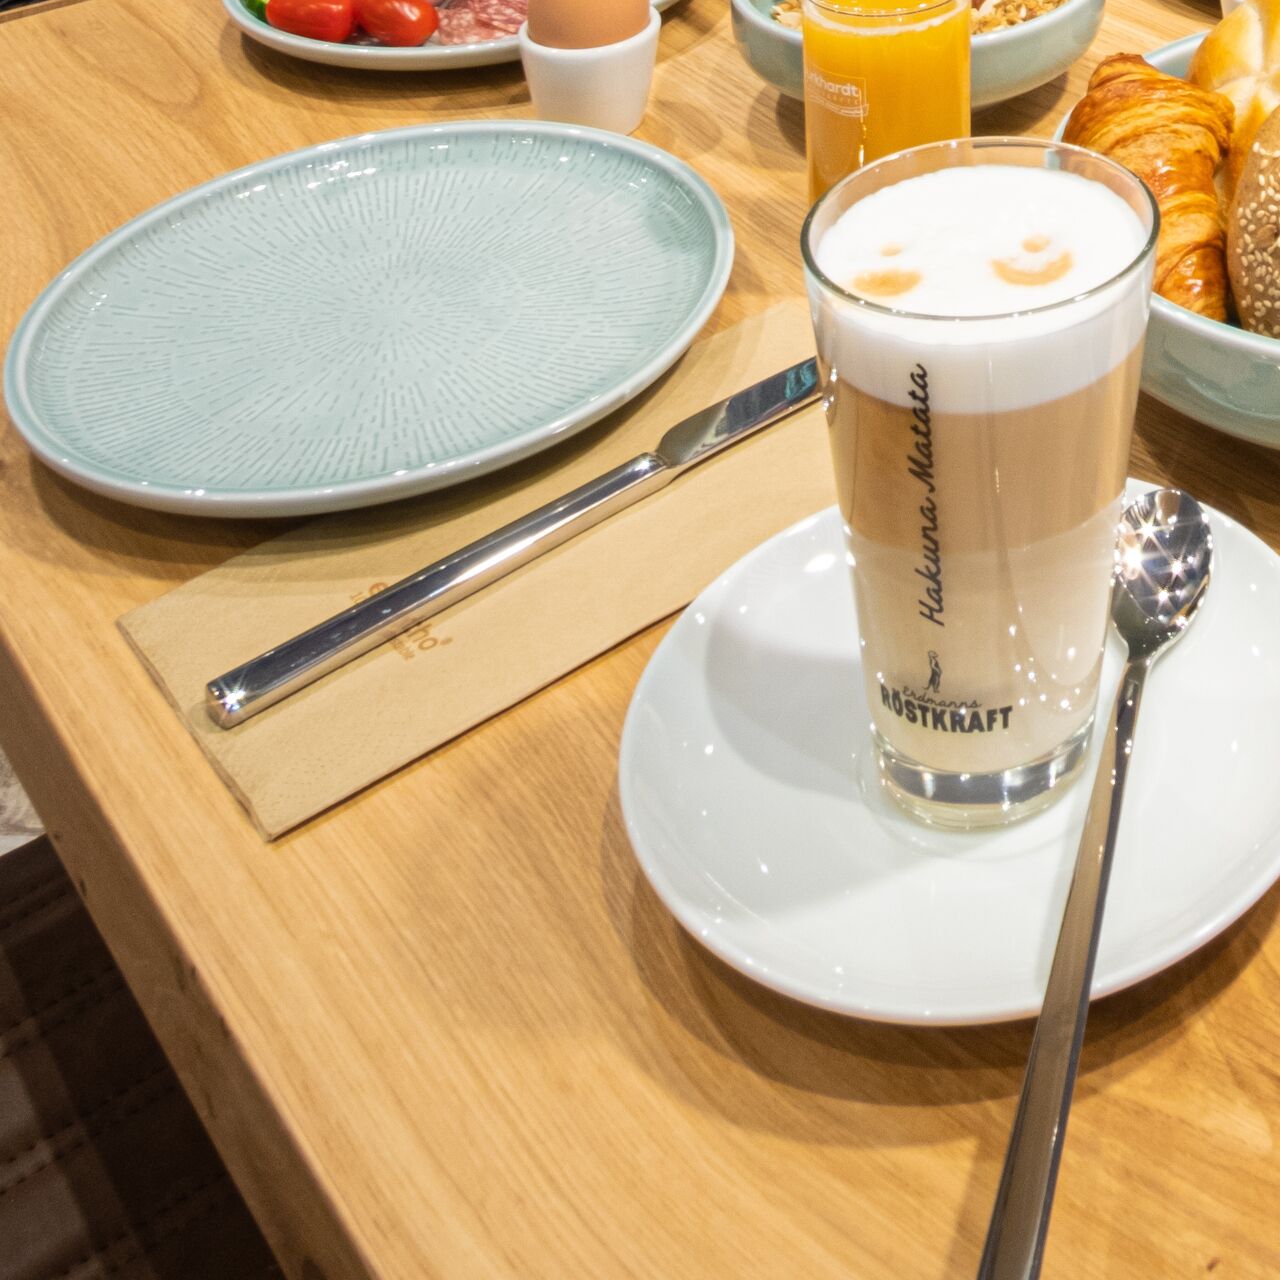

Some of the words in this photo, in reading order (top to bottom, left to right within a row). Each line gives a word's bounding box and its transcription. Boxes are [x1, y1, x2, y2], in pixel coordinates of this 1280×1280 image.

[907, 363, 936, 493] Matata
[915, 497, 944, 627] Hakuna
[881, 683, 1013, 733] RÖSTKRAFT
[902, 686, 981, 708] Erdmanns
